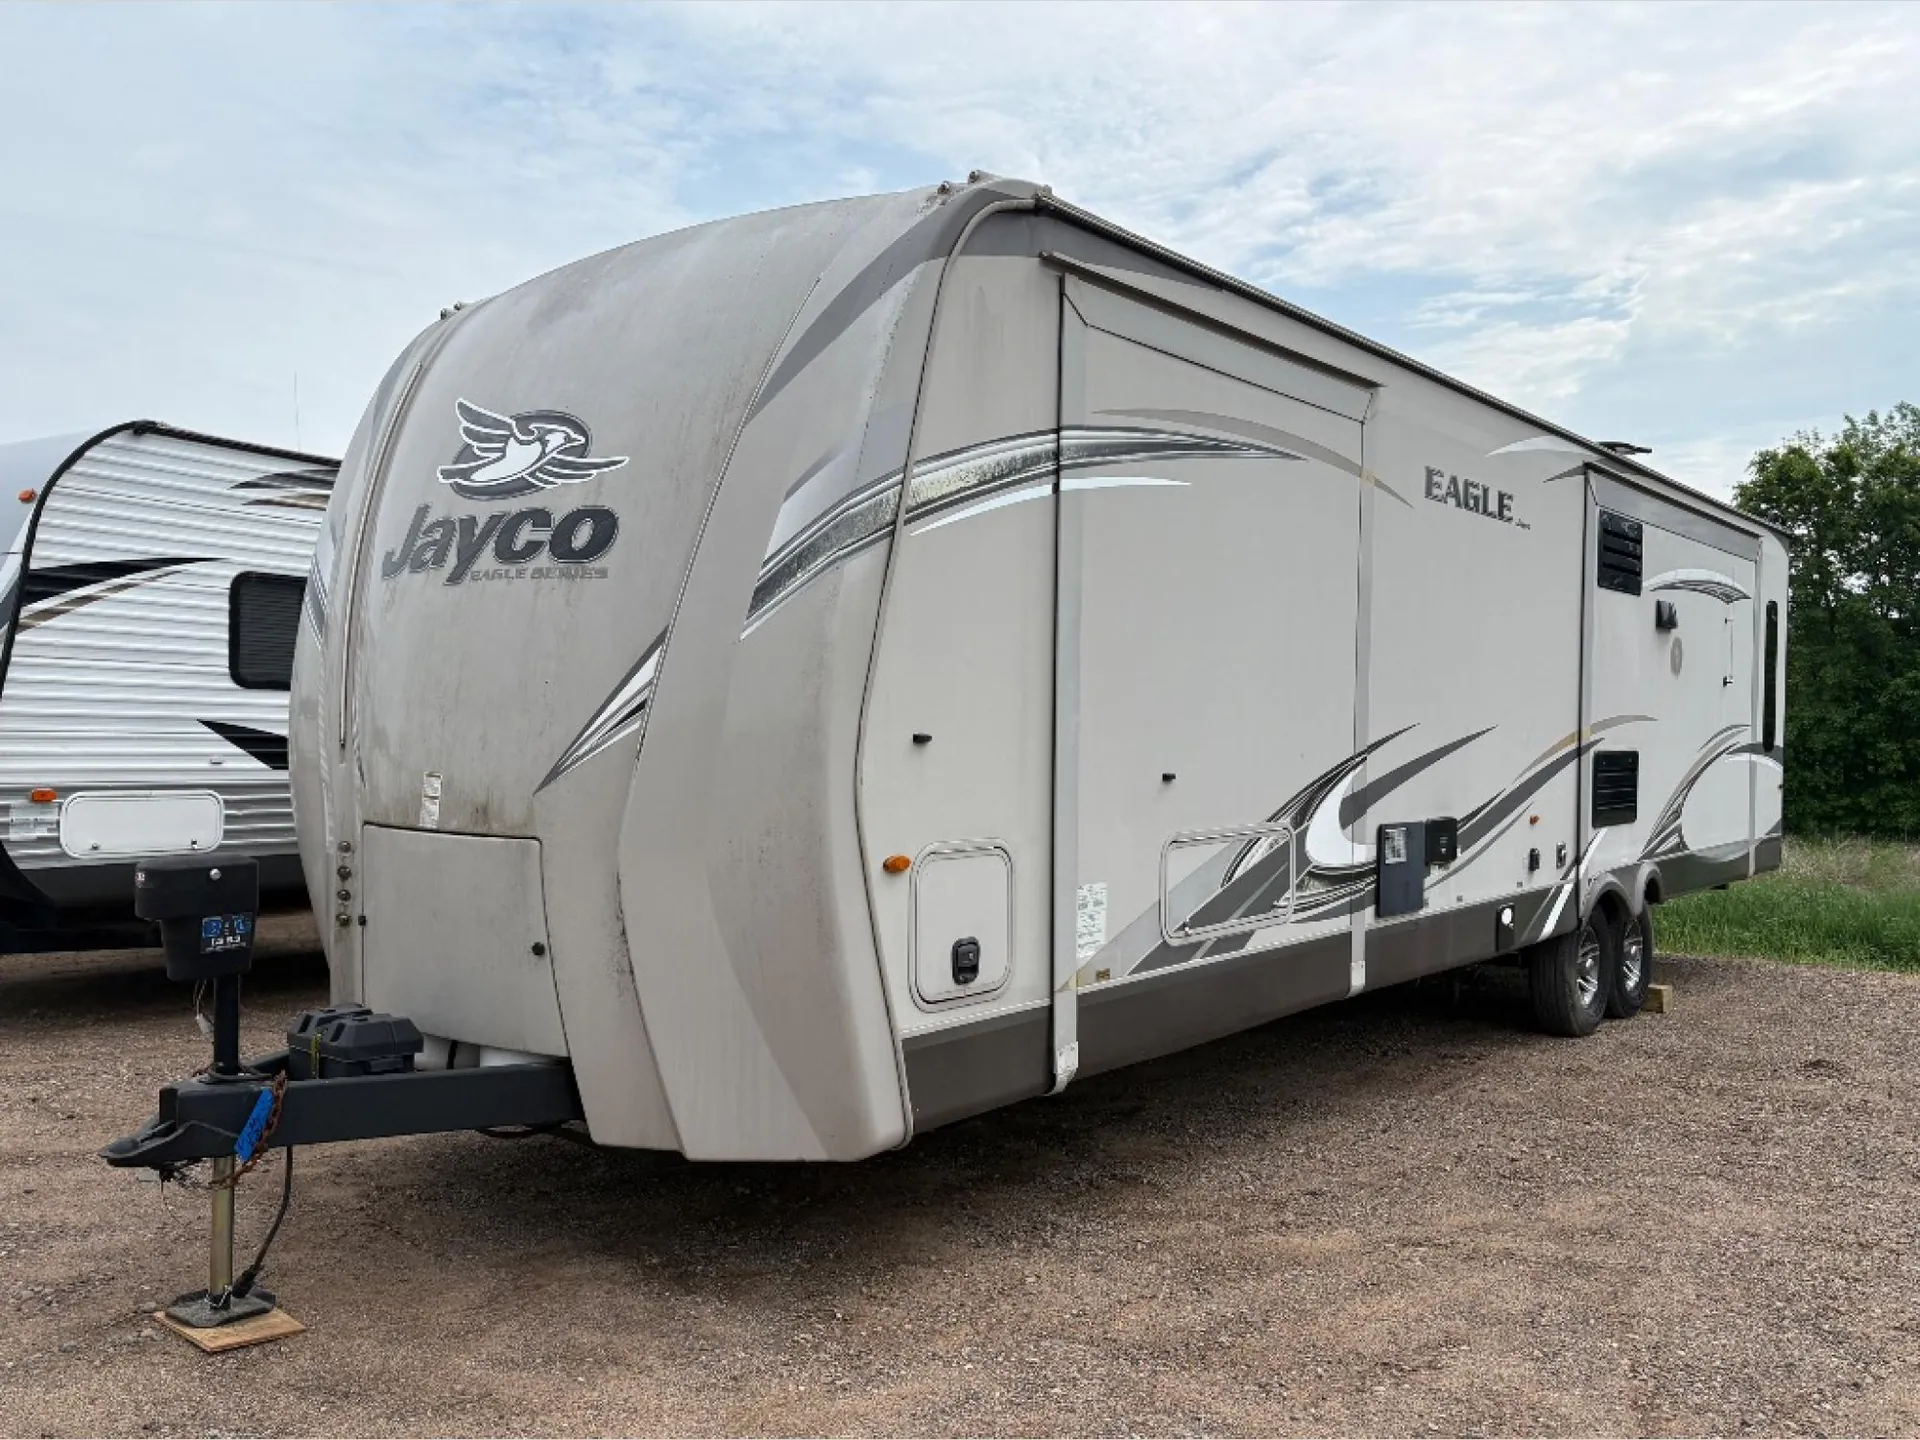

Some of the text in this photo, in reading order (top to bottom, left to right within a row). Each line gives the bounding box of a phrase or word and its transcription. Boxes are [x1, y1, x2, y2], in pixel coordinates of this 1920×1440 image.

[1424, 465, 1514, 524] EAGLE
[382, 503, 619, 586] Jayco
[470, 566, 609, 582] EAGLE SERIES
